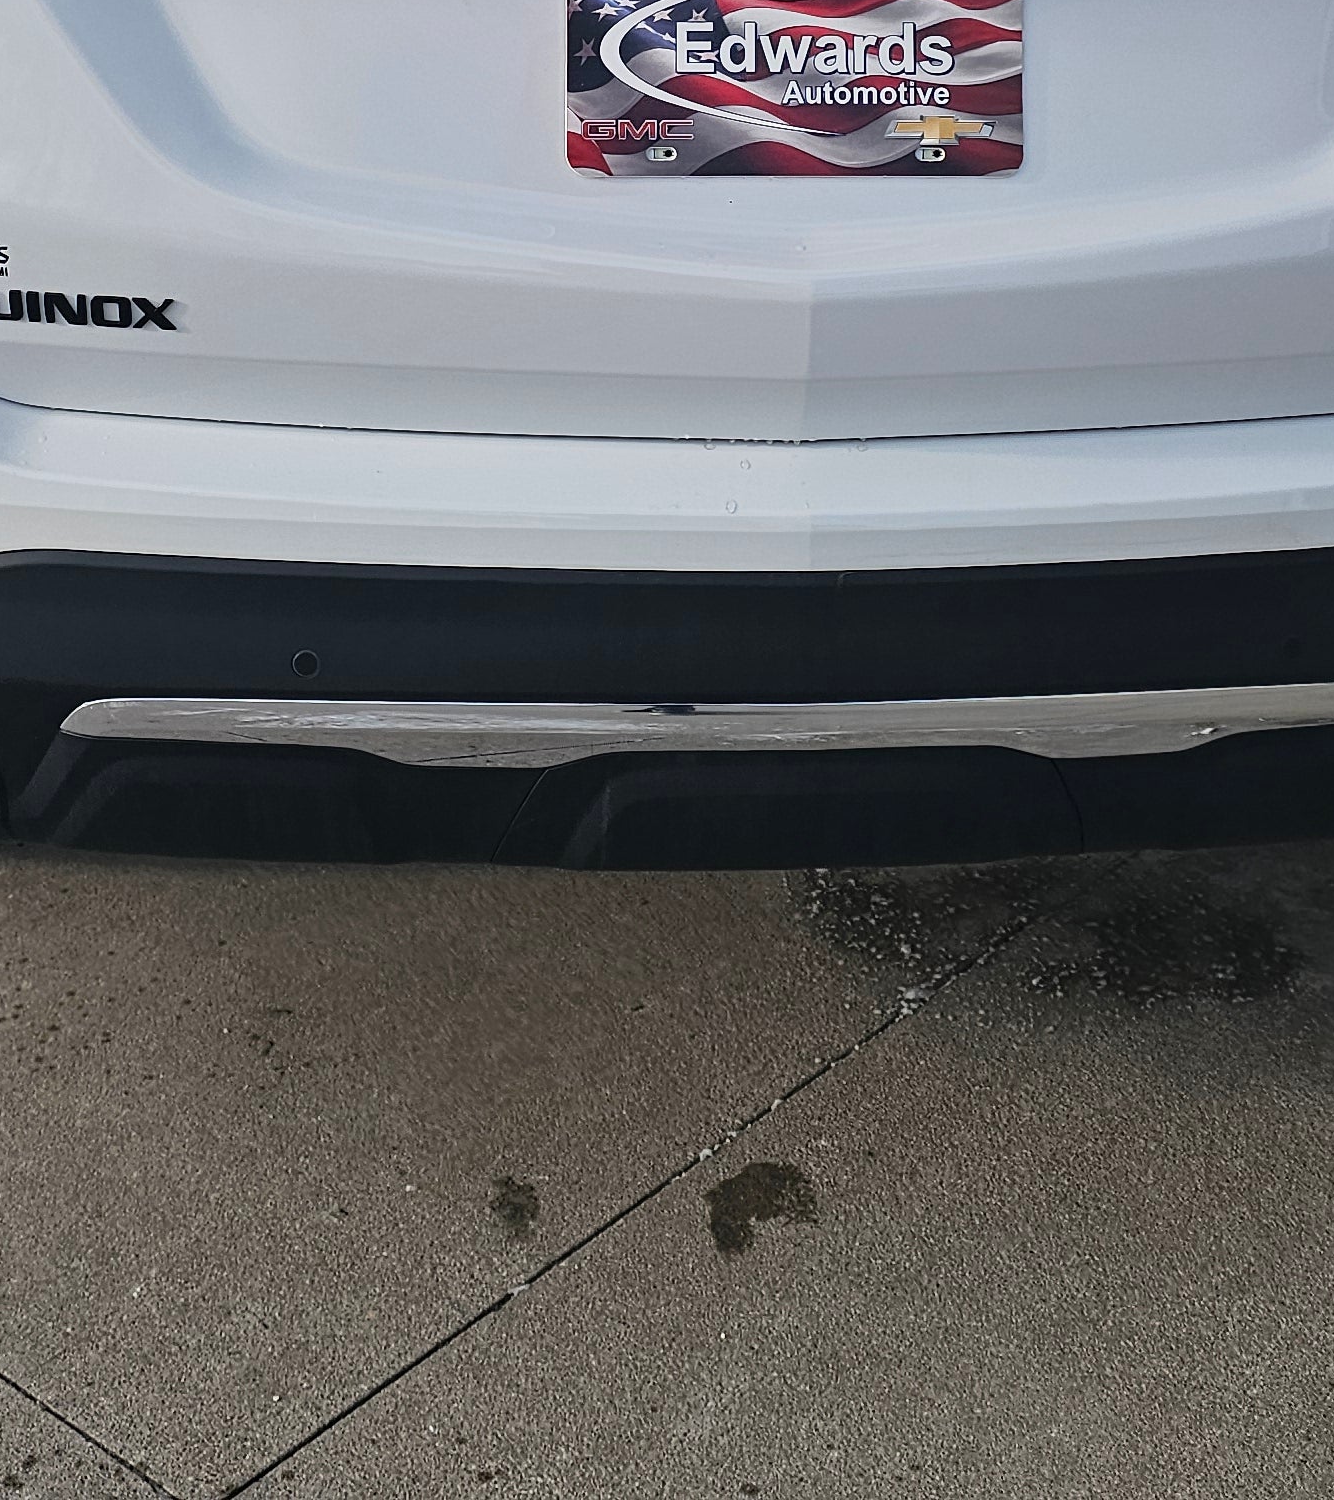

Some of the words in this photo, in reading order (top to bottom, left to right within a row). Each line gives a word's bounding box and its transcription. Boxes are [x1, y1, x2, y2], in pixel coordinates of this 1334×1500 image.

[675, 21, 955, 75] Edwards
[782, 80, 950, 106] Automotive
[581, 118, 694, 141] GMC
